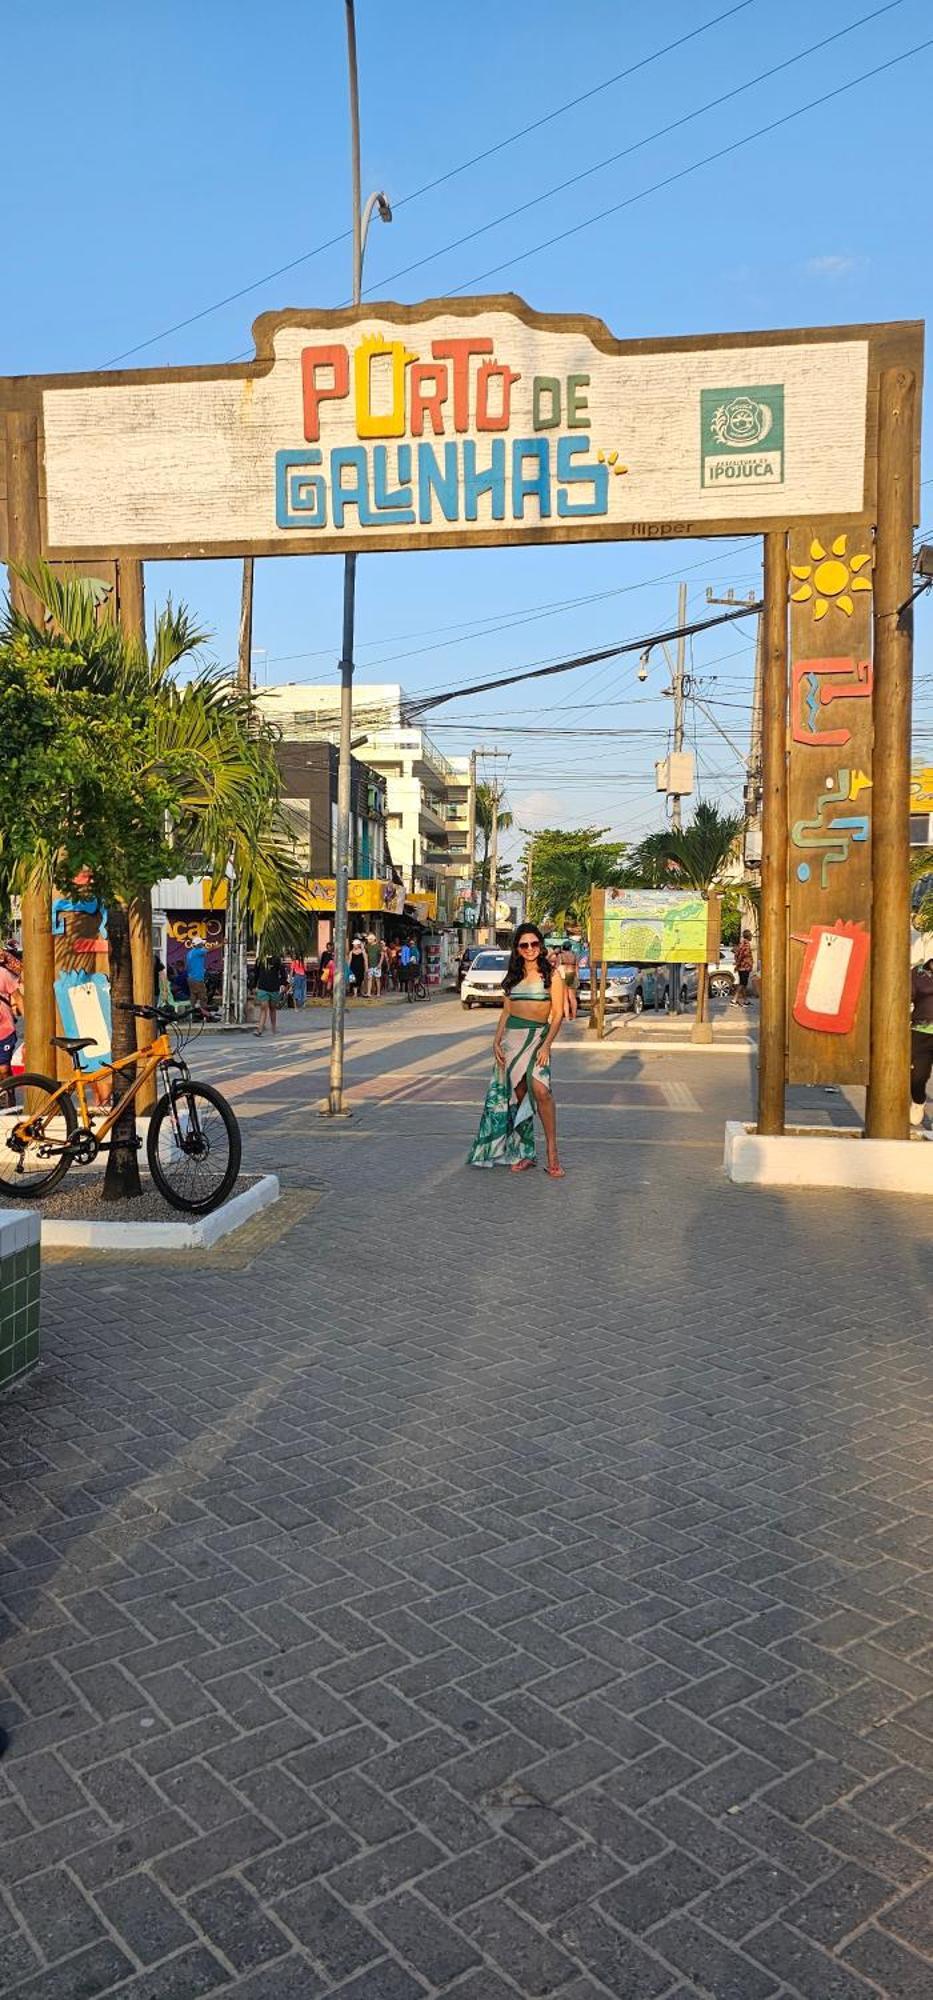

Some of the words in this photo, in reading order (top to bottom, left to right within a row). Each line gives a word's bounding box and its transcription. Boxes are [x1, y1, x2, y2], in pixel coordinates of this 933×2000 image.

[301, 332, 521, 442] PORTO
[533, 374, 591, 431] DE
[275, 435, 609, 529] GALINHAS
[709, 463, 774, 481] IPOJUCA
[631, 522, 696, 537] flipper
